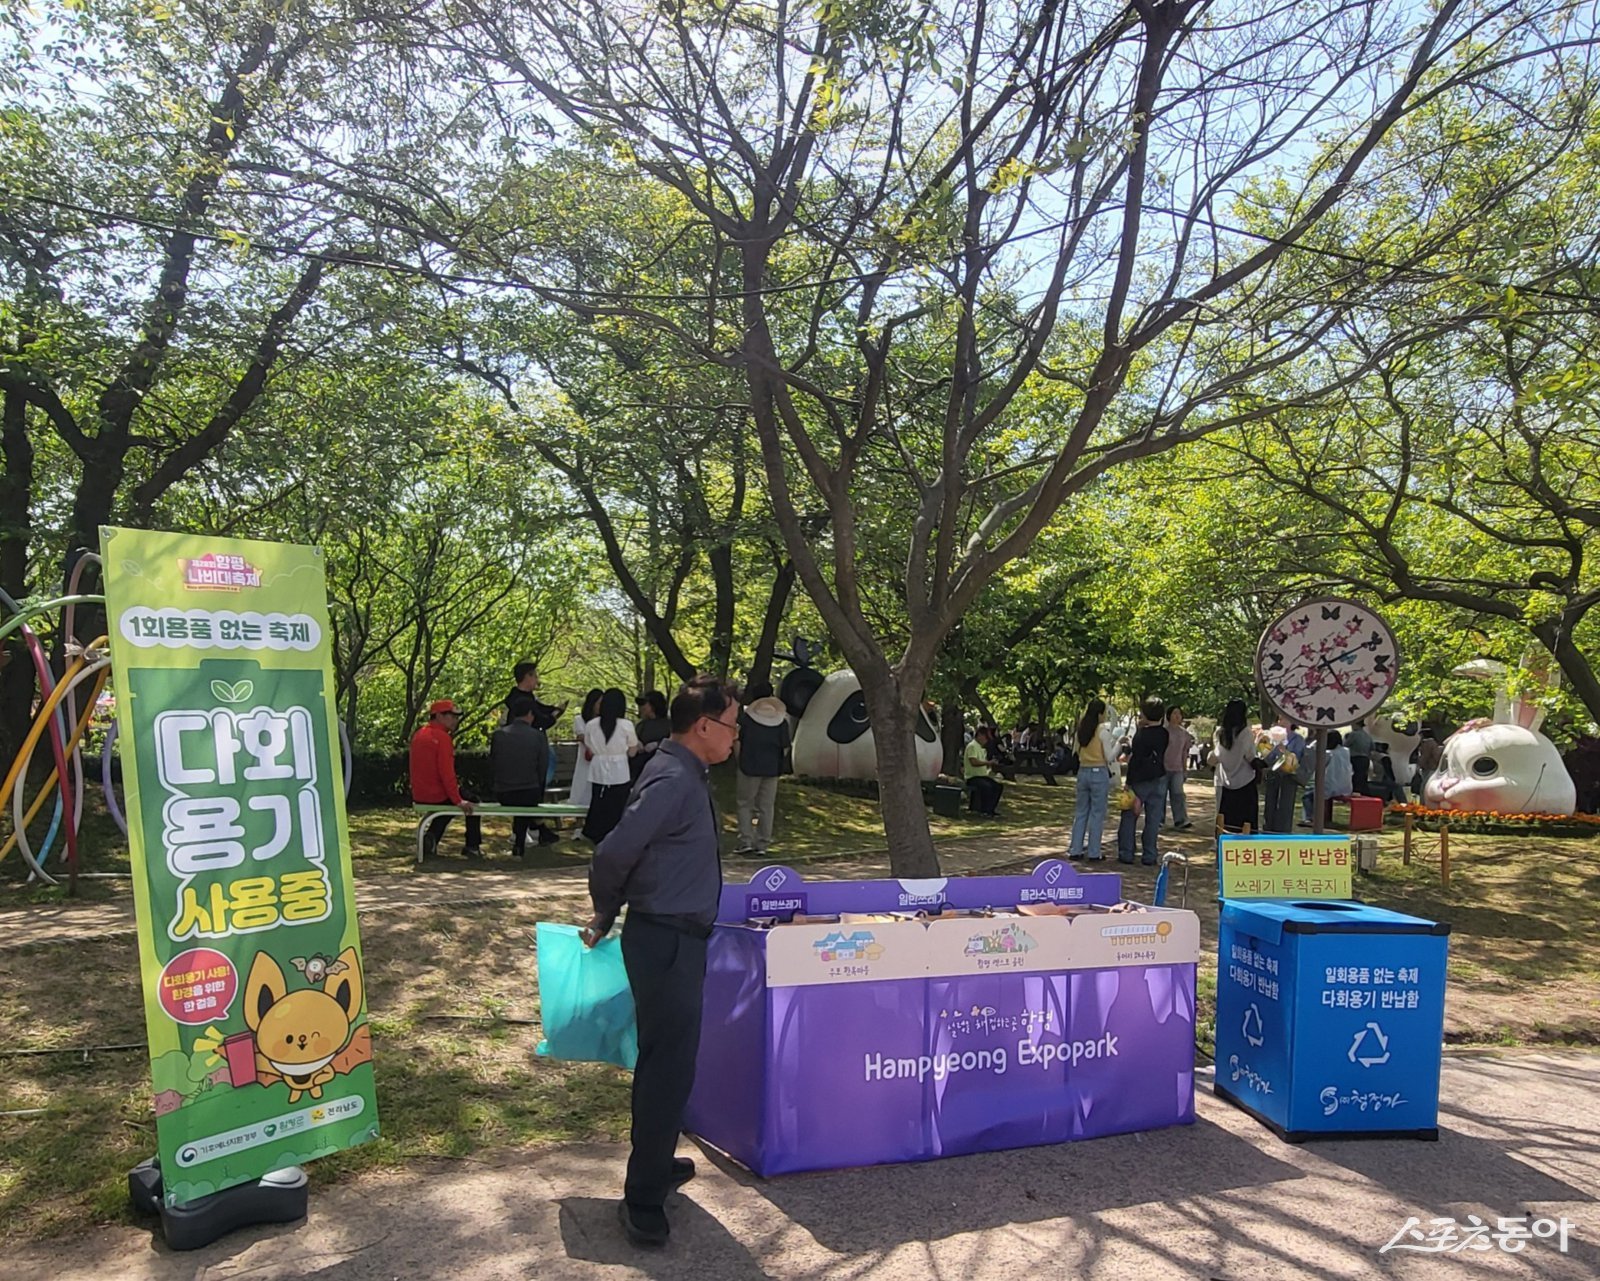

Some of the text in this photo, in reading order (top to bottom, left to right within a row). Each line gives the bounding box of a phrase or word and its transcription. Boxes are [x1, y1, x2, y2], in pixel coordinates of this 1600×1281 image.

[215, 555, 245, 570] 함평
[188, 568, 261, 587] 나비대축제
[129, 615, 311, 643] 1회용품 없는 축제
[155, 706, 315, 786] 다회
[164, 787, 322, 876] 용기
[1225, 848, 1349, 866] 다회용기 반납함
[1020, 887, 1084, 901] 플라스틱/페트병
[1234, 879, 1276, 894] 쓰레기
[1281, 878, 1338, 894] 투척금지
[172, 868, 328, 938] 사용중
[761, 898, 802, 911] 일반쓰레기
[898, 892, 947, 906] 일반쓰레기
[1231, 943, 1279, 976] 일회용품 없는 축제
[164, 965, 230, 987] 다회용기 사용!
[1229, 964, 1279, 1001] 다회용기 반납함
[1325, 967, 1419, 984] 일회용품 없는 축제
[172, 980, 225, 1000] 환경을 위한
[1321, 990, 1420, 1009] 다회용기 반납함
[183, 996, 217, 1013] 한 걸음
[1020, 1008, 1054, 1034] 함평
[864, 1031, 1119, 1083] Hampyeong Expopark
[200, 1131, 258, 1154] 기후에너지환경부
[327, 1100, 359, 1117] 전라남도
